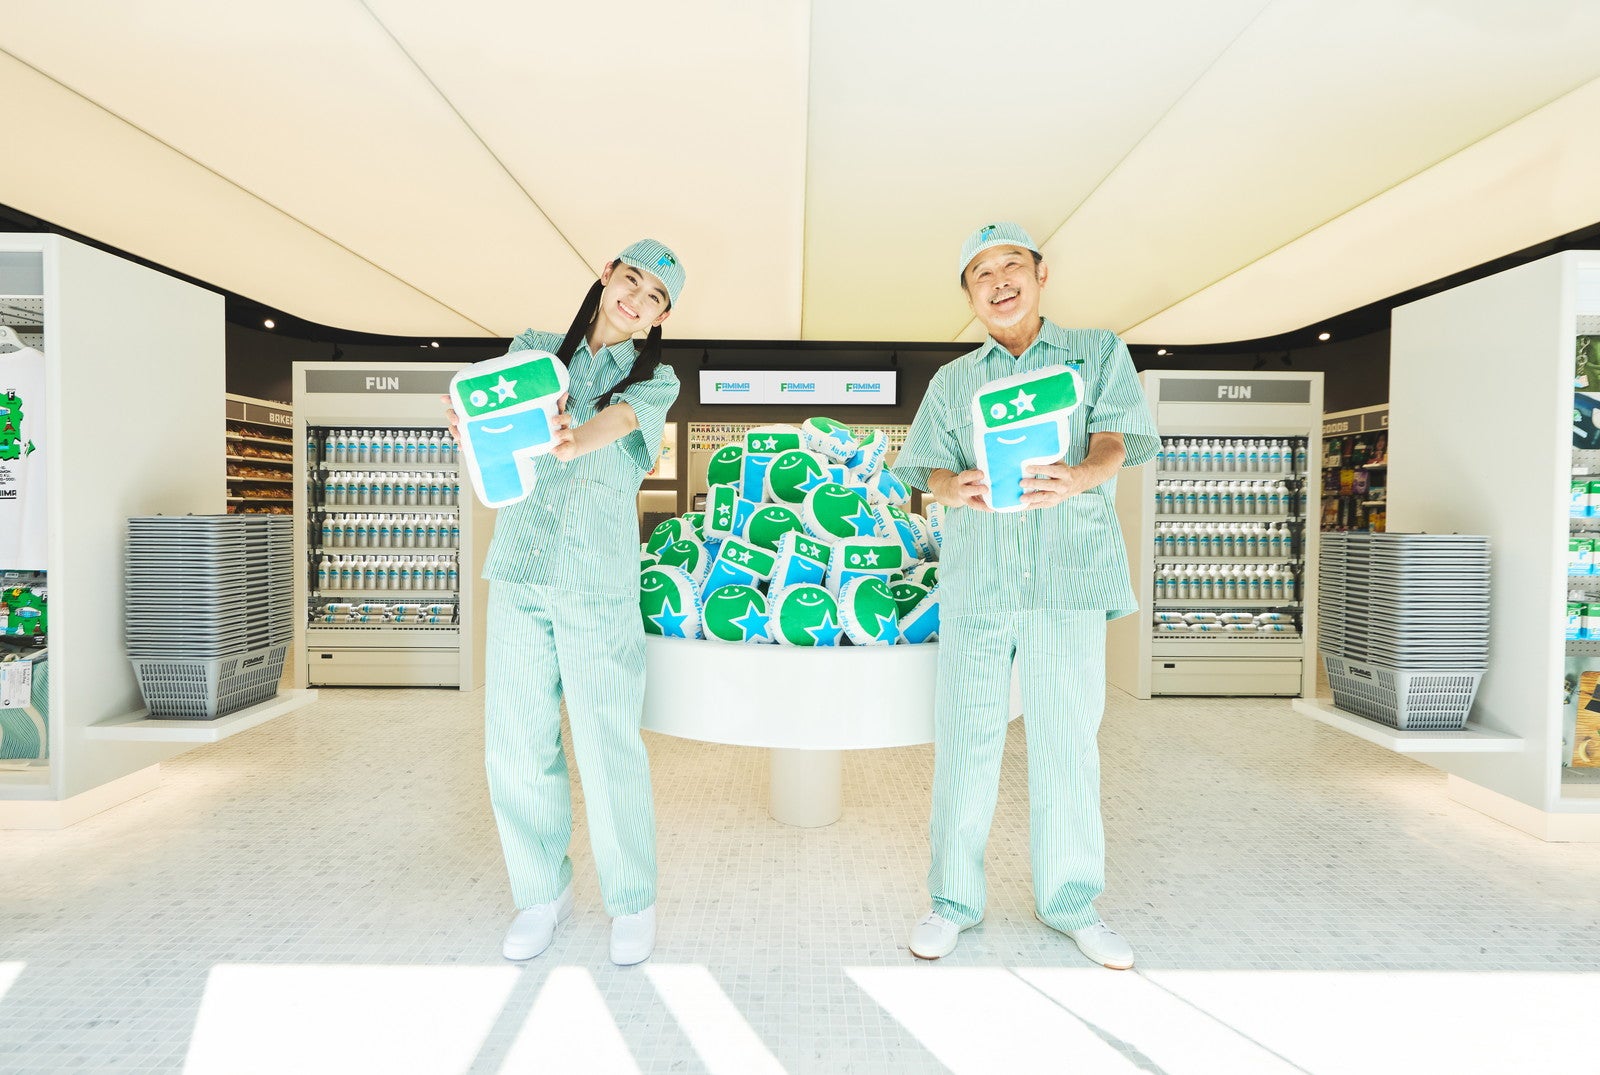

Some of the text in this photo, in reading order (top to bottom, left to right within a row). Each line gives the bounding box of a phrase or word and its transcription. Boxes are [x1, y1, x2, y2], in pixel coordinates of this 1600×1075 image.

[366, 377, 399, 390] FUN
[715, 383, 880, 392] FAMIMA FAMIMA FAMIMA
[1217, 385, 1252, 399] FUN
